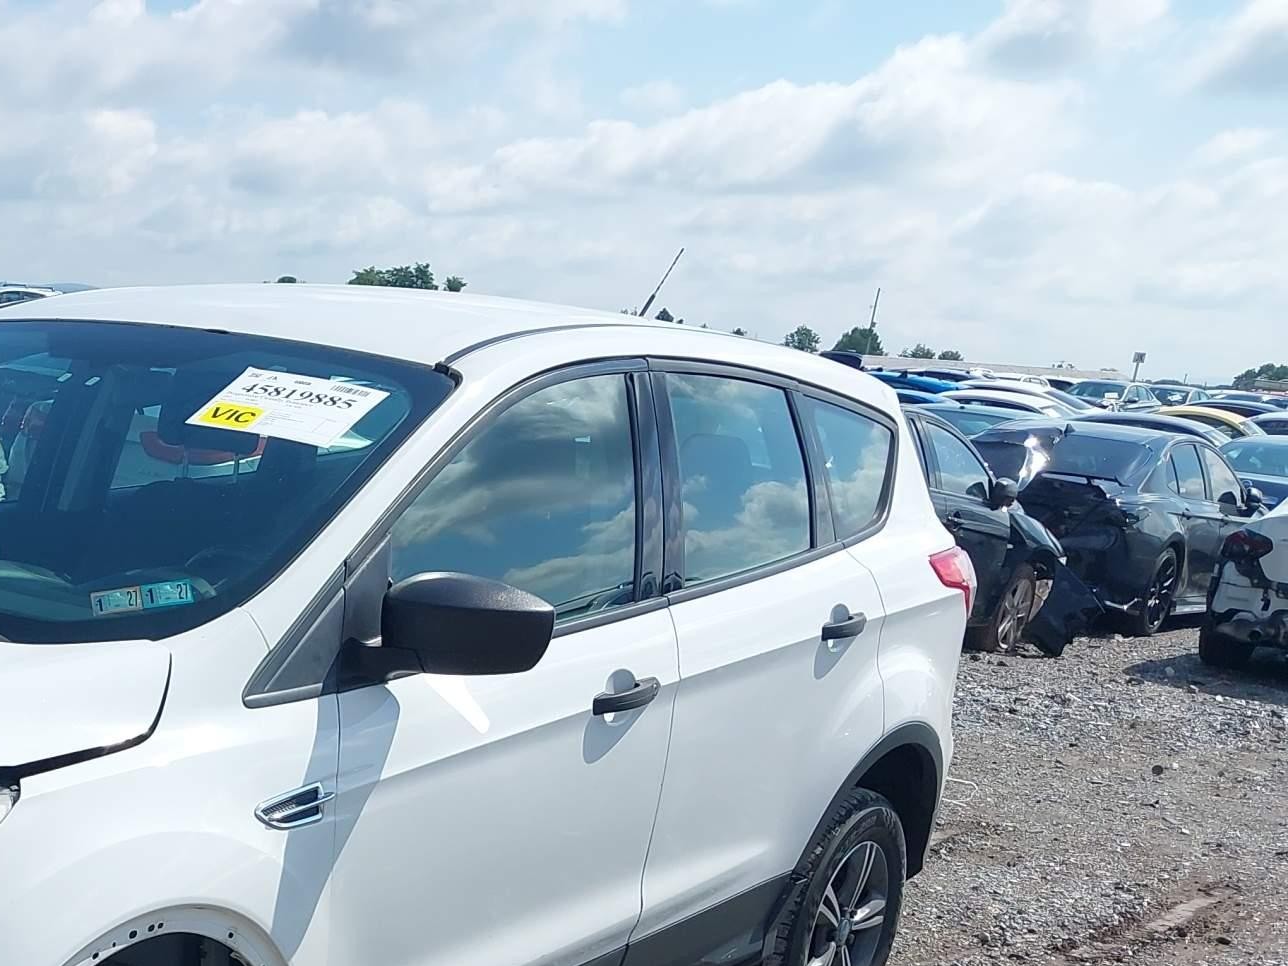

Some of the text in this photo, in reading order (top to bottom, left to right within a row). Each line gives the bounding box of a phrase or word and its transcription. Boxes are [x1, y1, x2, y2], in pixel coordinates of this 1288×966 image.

[241, 383, 357, 410] 45819885
[211, 406, 256, 423] VIC
[127, 590, 138, 607] 27
[176, 583, 188, 600] 27
